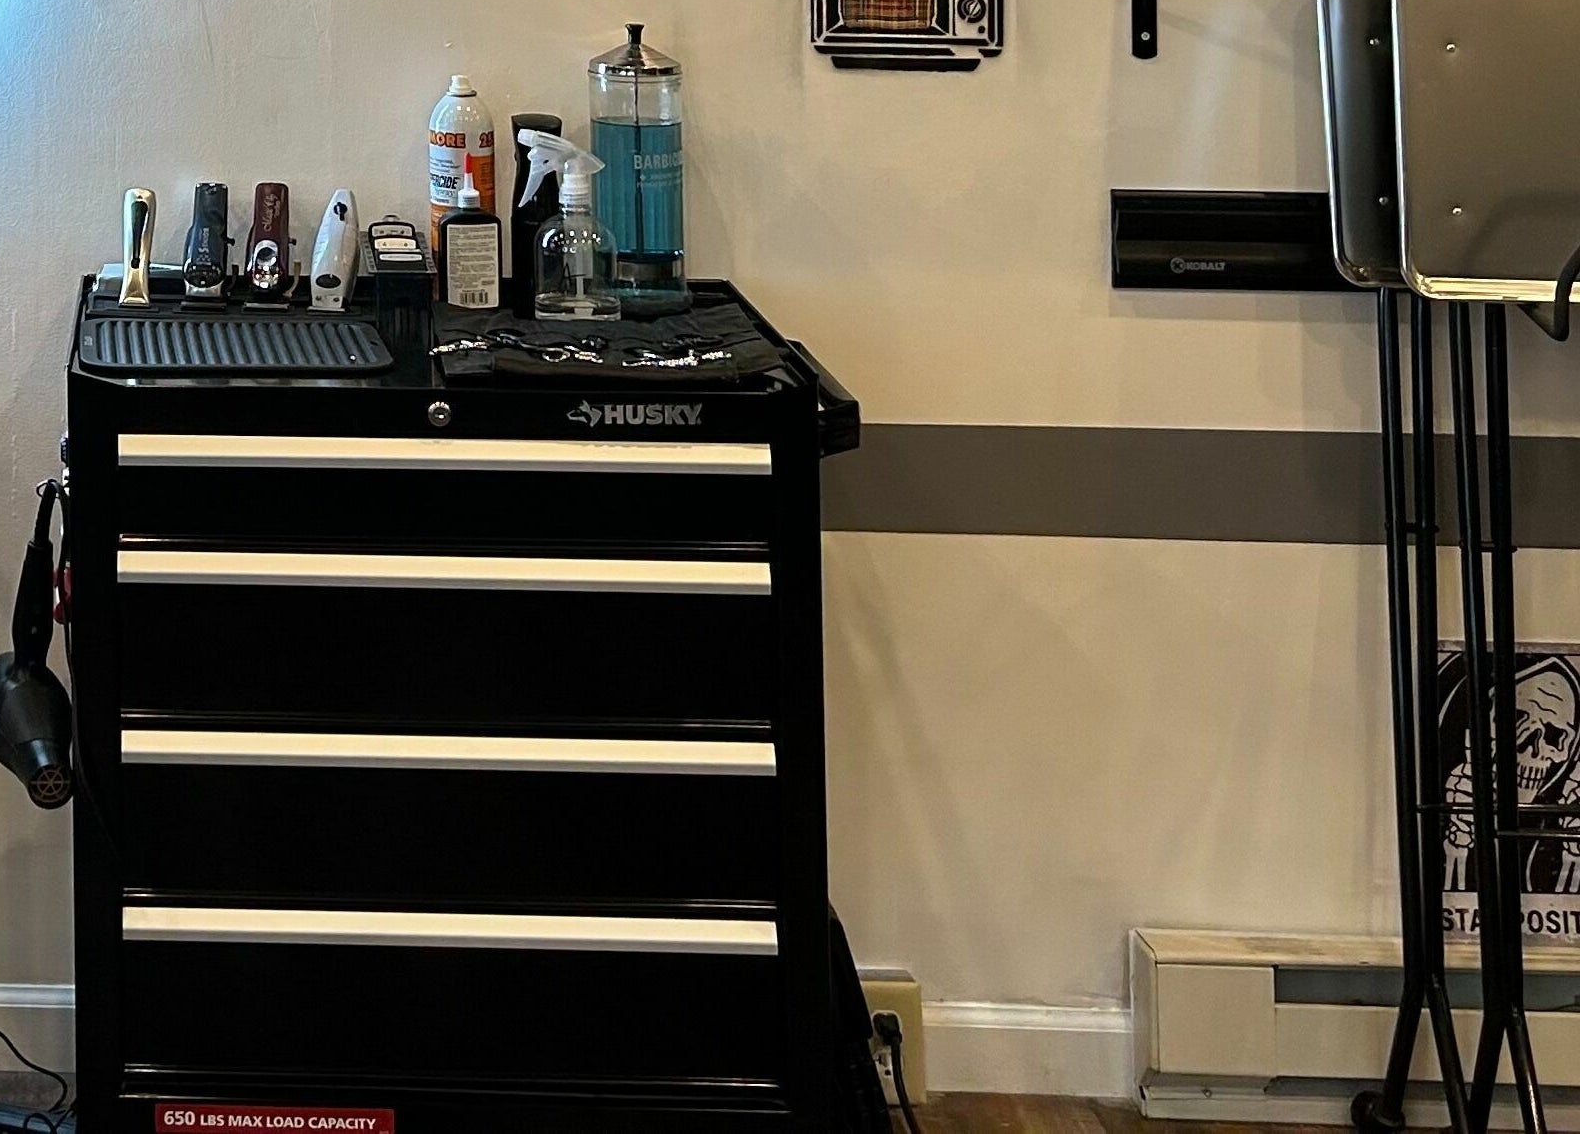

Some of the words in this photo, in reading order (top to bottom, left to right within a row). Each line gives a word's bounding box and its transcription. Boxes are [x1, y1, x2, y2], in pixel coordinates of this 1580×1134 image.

[1186, 262, 1226, 271] KOBALT
[604, 404, 701, 426] HUSKY
[1441, 908, 1482, 932] STA
[1520, 909, 1580, 934] OSIT
[164, 1111, 196, 1126] 650
[200, 1114, 224, 1127] LBS
[228, 1115, 263, 1128] MAX
[266, 1116, 305, 1129] LOAD
[308, 1117, 376, 1130] CAPACITY
